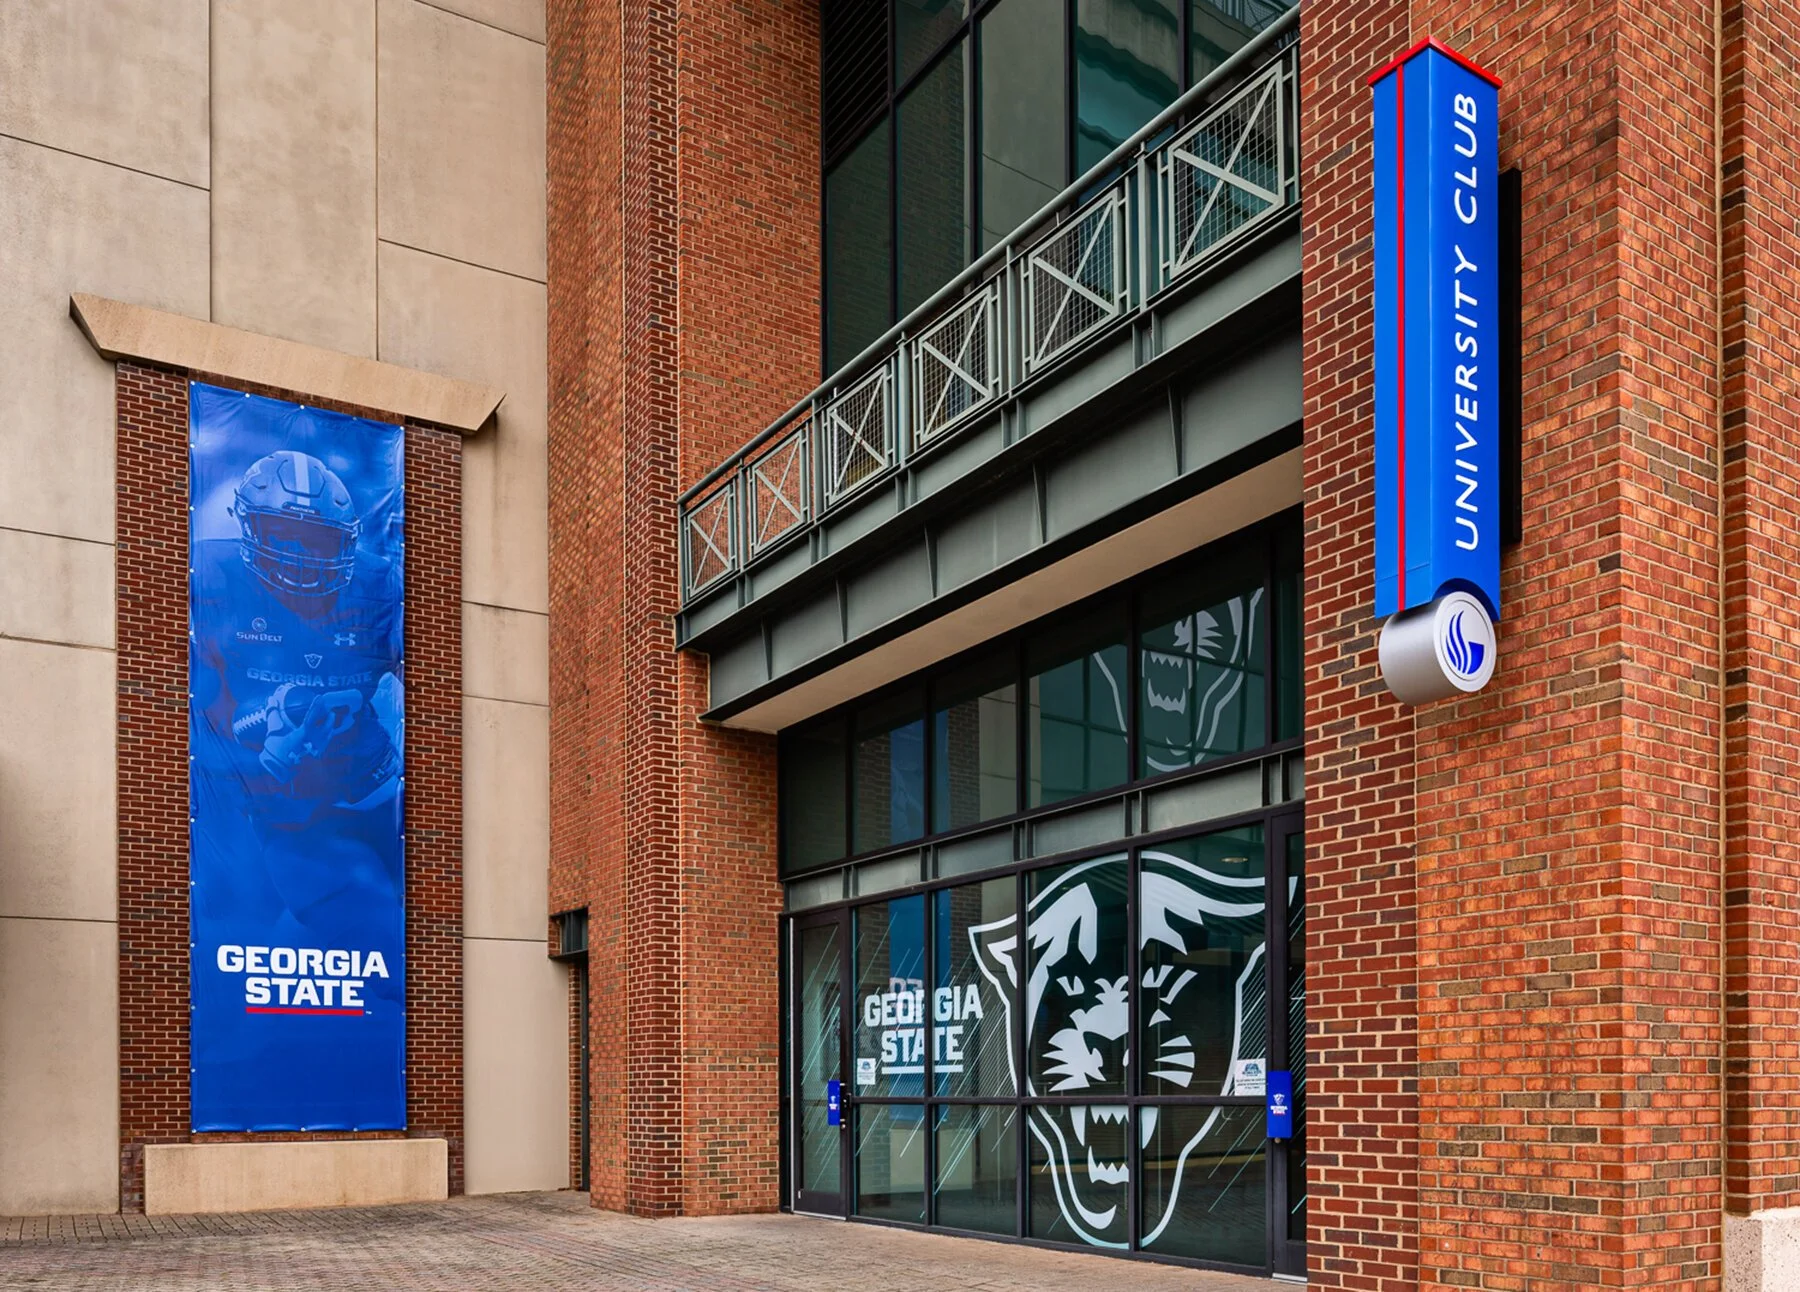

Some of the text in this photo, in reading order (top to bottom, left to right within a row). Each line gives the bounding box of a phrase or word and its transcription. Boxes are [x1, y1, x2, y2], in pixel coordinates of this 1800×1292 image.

[1454, 93, 1479, 551] UNIVERSITY CLUB
[246, 667, 373, 688] GEORGIA STATE
[216, 944, 390, 979] GEORGIA
[245, 976, 365, 1007] STATE
[881, 1025, 964, 1063] STATE
